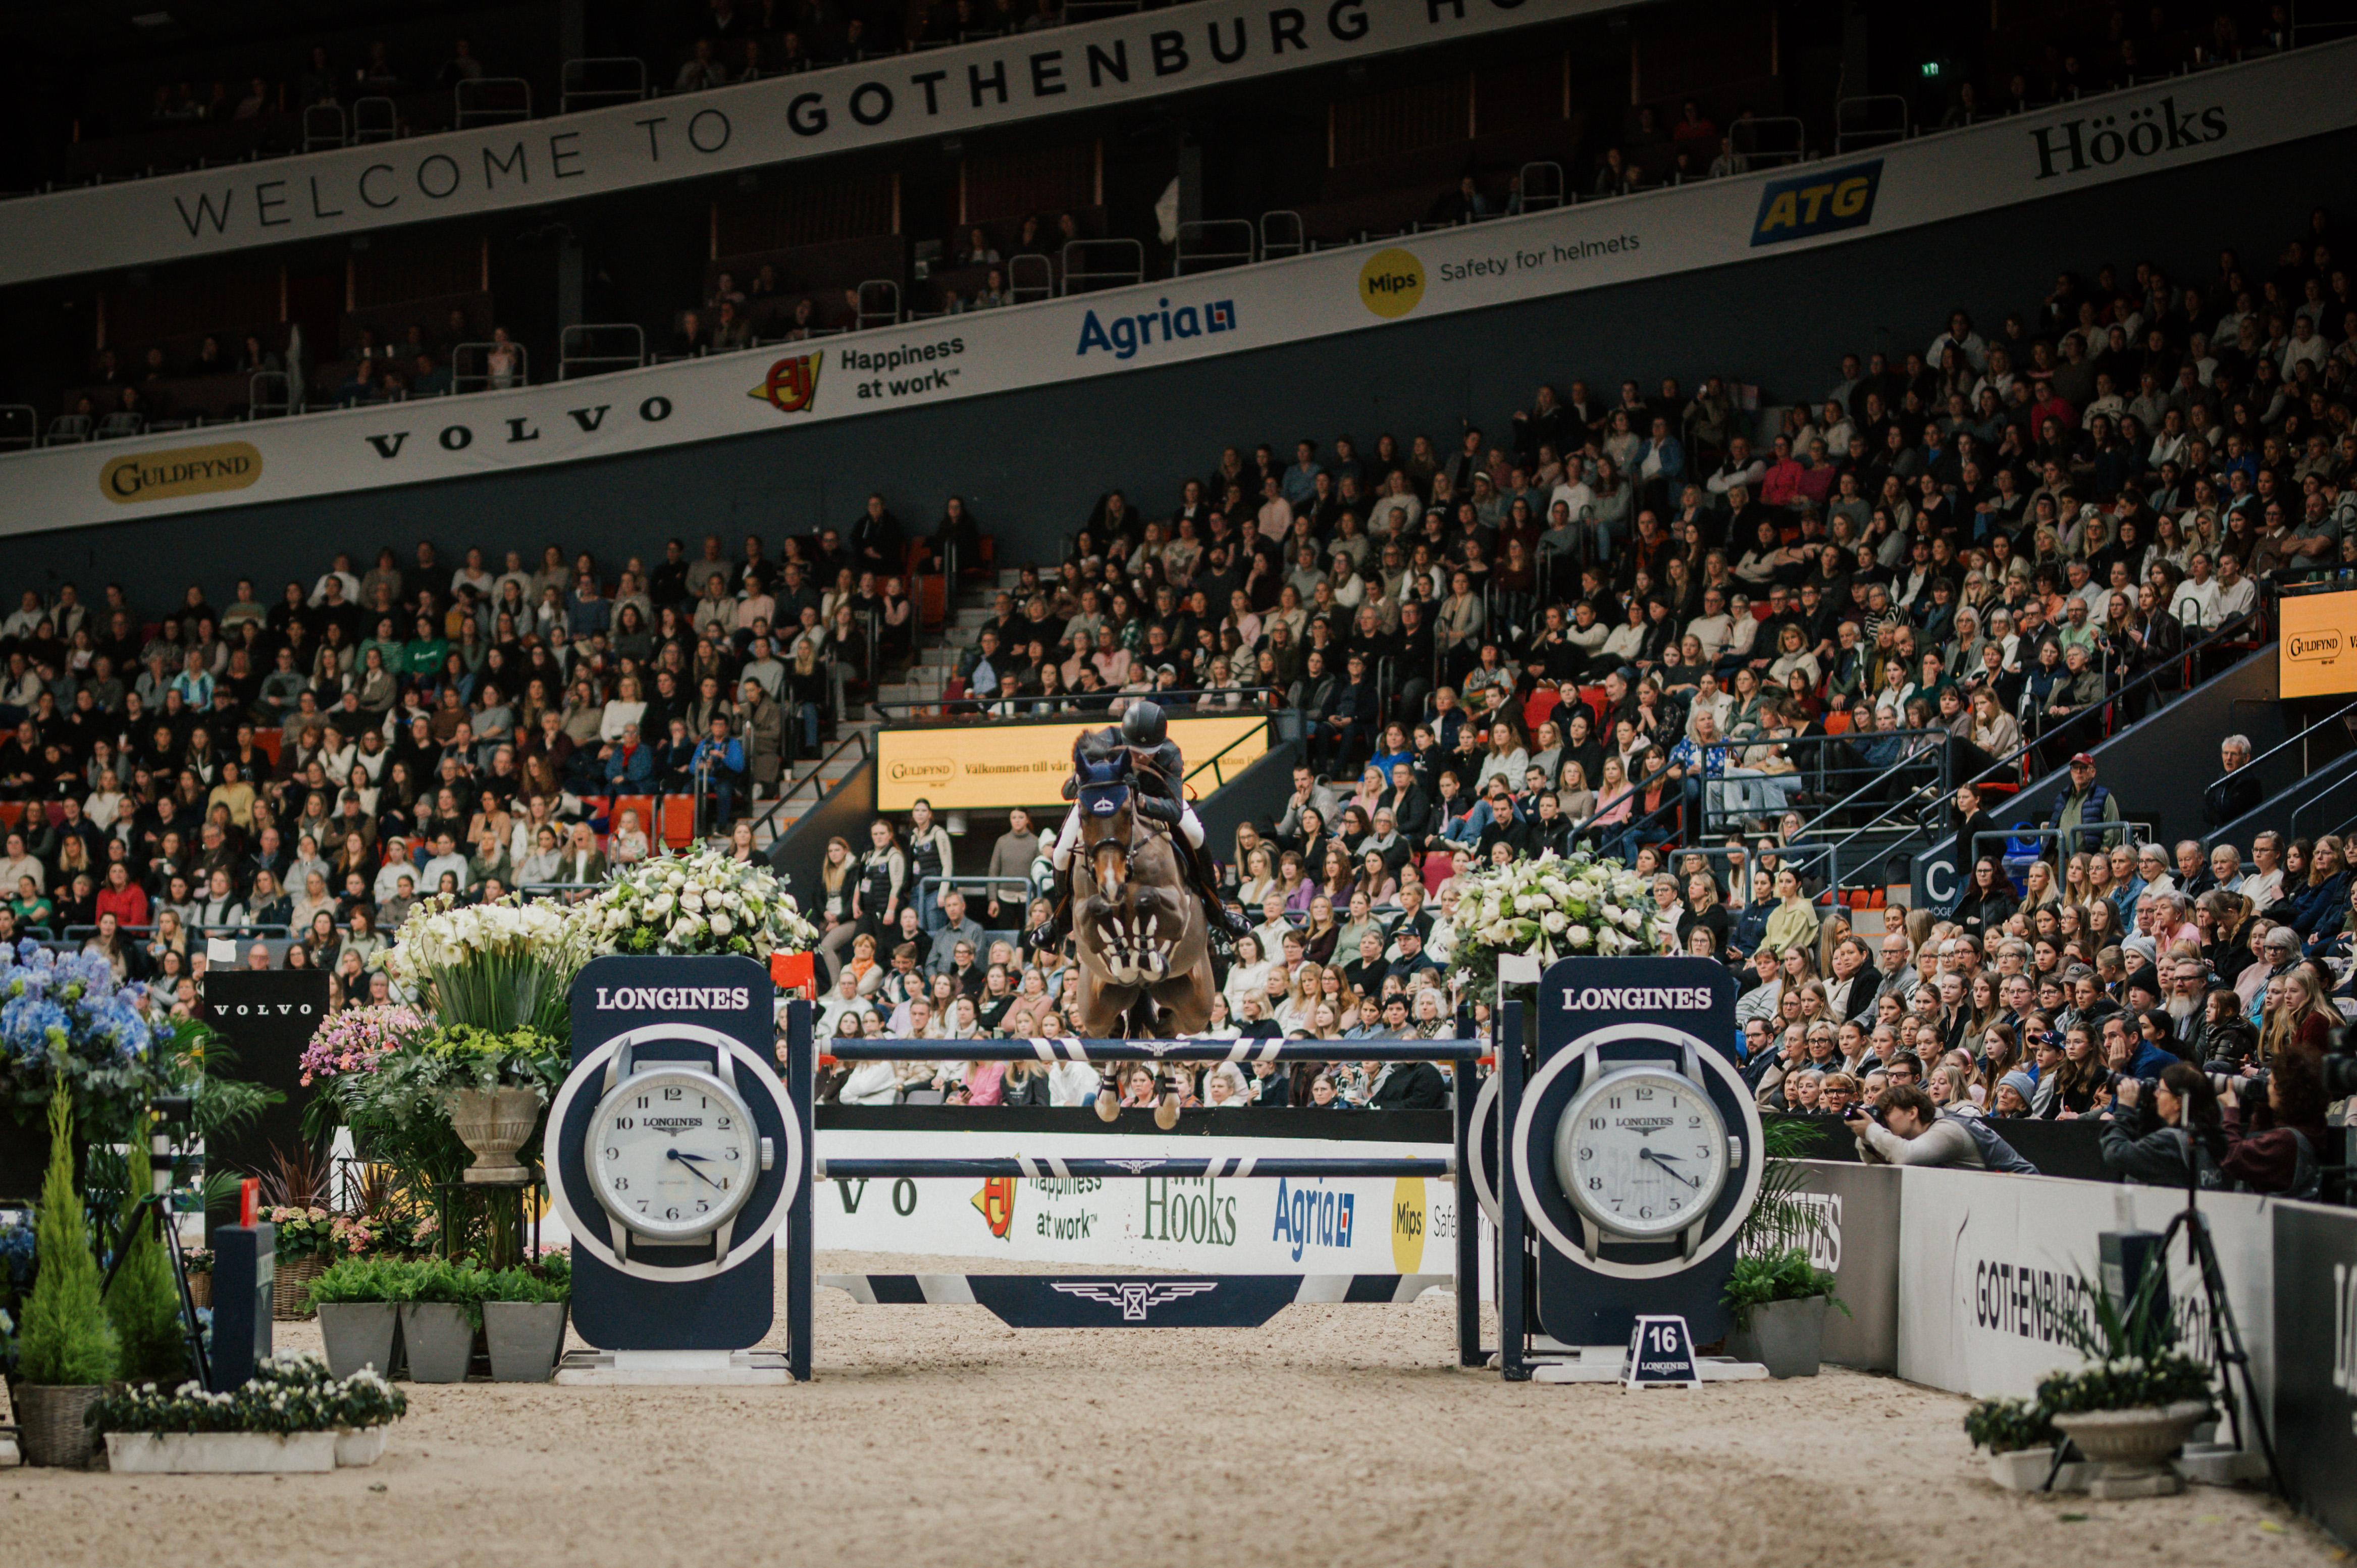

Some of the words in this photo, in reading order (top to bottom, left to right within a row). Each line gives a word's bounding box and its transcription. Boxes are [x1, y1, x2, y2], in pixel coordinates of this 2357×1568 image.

[174, 132, 585, 237] WELCOME
[635, 109, 730, 162] TO
[787, 0, 1370, 136] GOTHENBURG
[2029, 96, 2228, 180] Hööks
[1760, 177, 1868, 232] ATG
[1440, 257, 1508, 282] Safety
[1516, 250, 1547, 269] for
[1553, 234, 1640, 263] helmets
[1369, 272, 1417, 295] Mips
[1076, 298, 1201, 359] Agria
[842, 337, 965, 373] Happiness
[857, 379, 882, 398] at
[366, 396, 672, 458] VOLVO
[111, 456, 250, 496] GULDFYND
[2291, 638, 2338, 656] GULDFYND
[892, 763, 950, 779] GULDFYND
[965, 762, 1029, 774] Välkommen
[1032, 761, 1047, 772] till
[1926, 860, 1956, 902] C
[1927, 905, 1953, 917] HÖGE
[596, 987, 749, 1010] LONGINES
[1562, 987, 1712, 1010] LONGINES
[214, 1004, 312, 1016] VOLVO
[664, 1088, 682, 1101] 12
[1636, 1088, 1653, 1101] 12
[638, 1096, 648, 1109] 11
[701, 1096, 706, 1109] 1
[1610, 1097, 1621, 1109] 11
[1672, 1096, 1677, 1108] 1
[616, 1117, 634, 1130] 10
[643, 1117, 703, 1127] LONGINES
[718, 1117, 730, 1130] 2
[1590, 1117, 1606, 1130] 10
[1616, 1117, 1673, 1127] LONGINES
[1689, 1116, 1701, 1129] 2
[606, 1147, 619, 1160] 9
[725, 1147, 739, 1161] 3
[1580, 1147, 1593, 1161] 9
[1696, 1145, 1710, 1159] 3
[615, 1177, 628, 1190] 8
[717, 1177, 730, 1190] 4
[1589, 1177, 1602, 1190] 8
[1689, 1175, 1702, 1188] 4
[637, 1200, 649, 1212] 7
[696, 1199, 709, 1212] 5
[1611, 1199, 1623, 1211] 7
[1669, 1198, 1681, 1211] 5
[666, 1207, 679, 1220] 6
[1640, 1206, 1652, 1219] 6
[1037, 1210, 1052, 1238] at
[1273, 1177, 1334, 1263] Agria
[1396, 1201, 1422, 1241] Mips
[1434, 1205, 1456, 1238] Safe
[1649, 1326, 1677, 1353] 16
[1641, 1362, 1689, 1370] LONGINES
